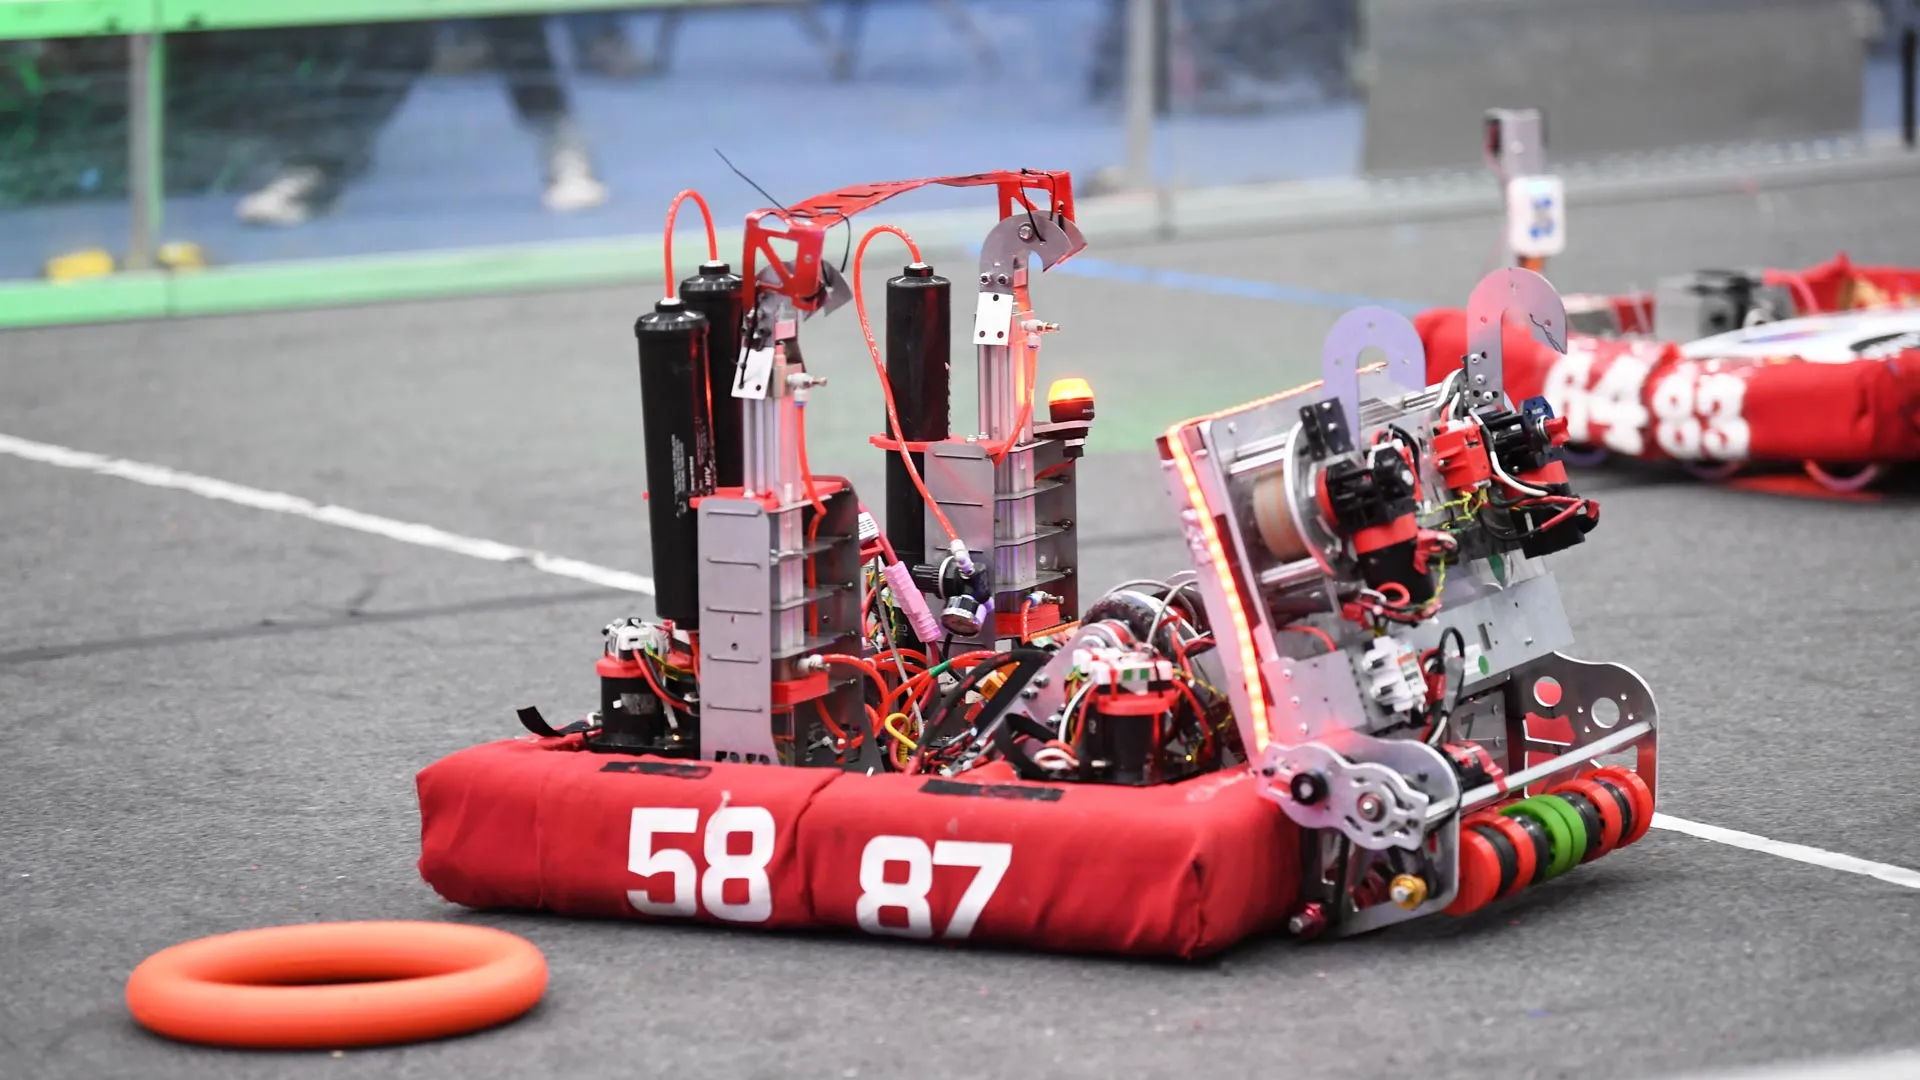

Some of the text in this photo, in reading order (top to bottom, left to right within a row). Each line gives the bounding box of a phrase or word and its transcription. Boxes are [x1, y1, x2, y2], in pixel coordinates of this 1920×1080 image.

[1544, 350, 1750, 460] 64 83
[626, 806, 1013, 939] 58 87
